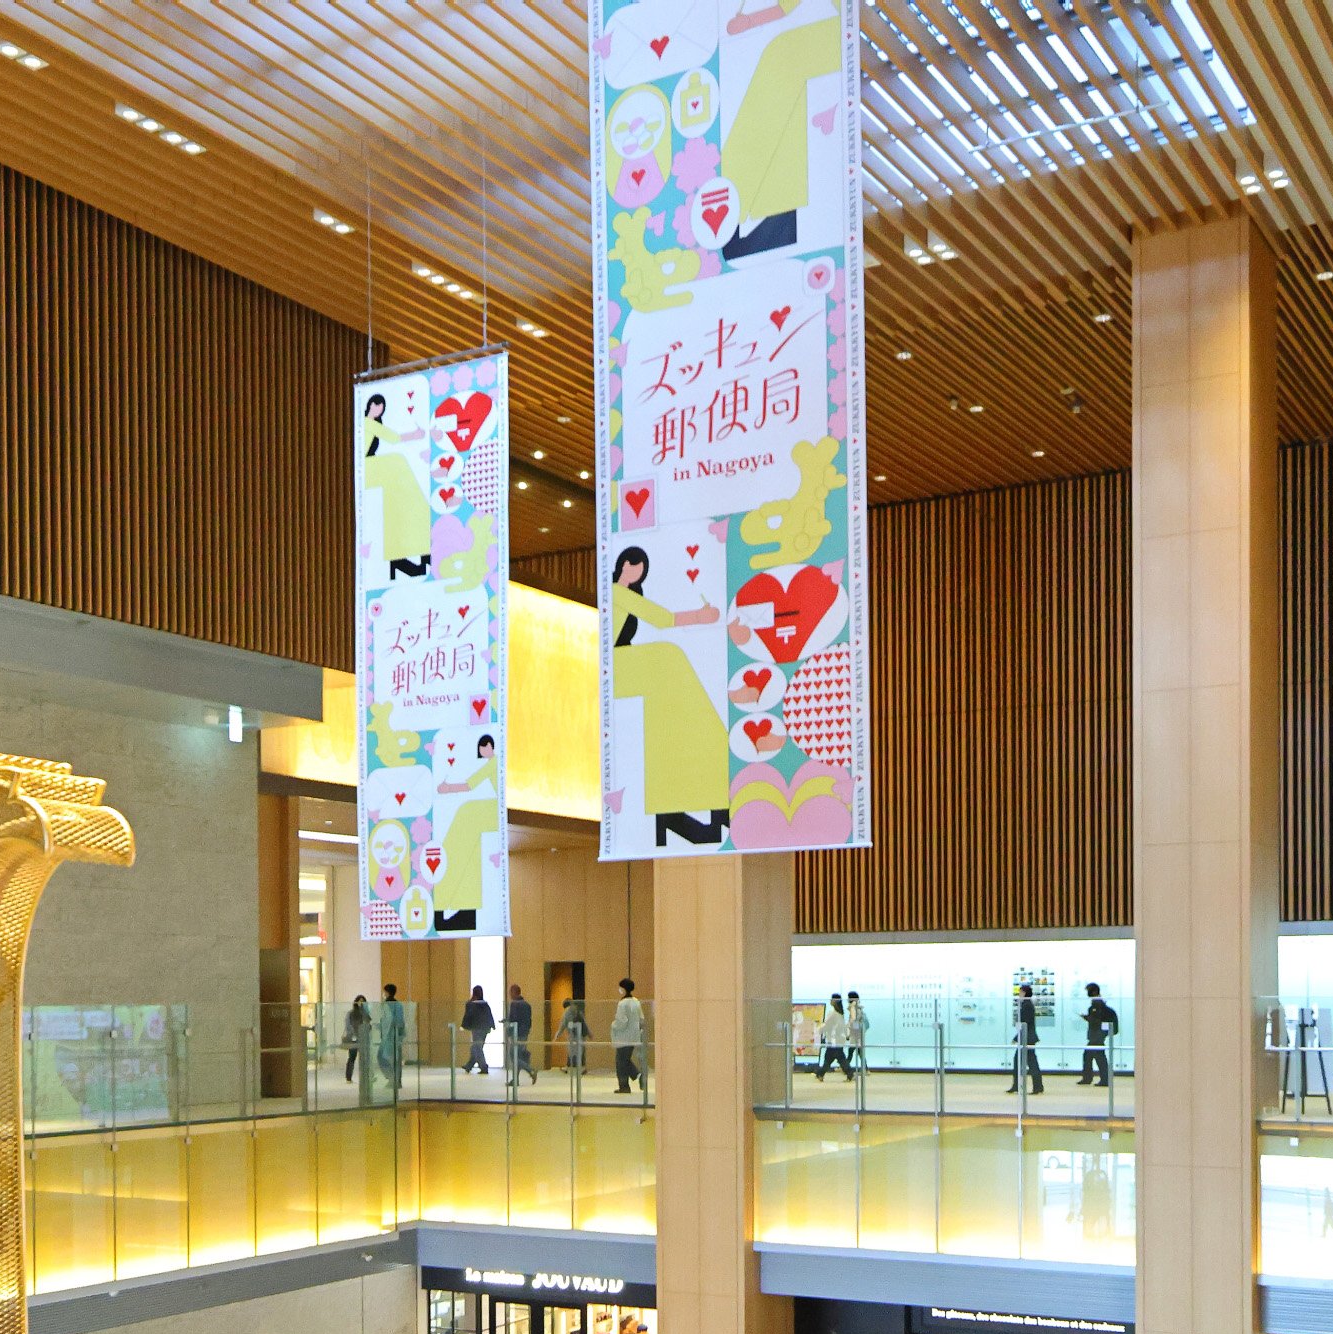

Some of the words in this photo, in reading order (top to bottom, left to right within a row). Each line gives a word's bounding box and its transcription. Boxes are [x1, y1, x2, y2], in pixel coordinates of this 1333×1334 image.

[637, 310, 823, 404] ズッキュン
[652, 369, 799, 465] 郵便局
[673, 467, 690, 481] in
[697, 452, 774, 478] Nagoya
[384, 608, 485, 656] ズッキュン
[391, 643, 474, 695] 郵便局
[403, 697, 413, 707] in
[416, 693, 460, 706] Nagoya
